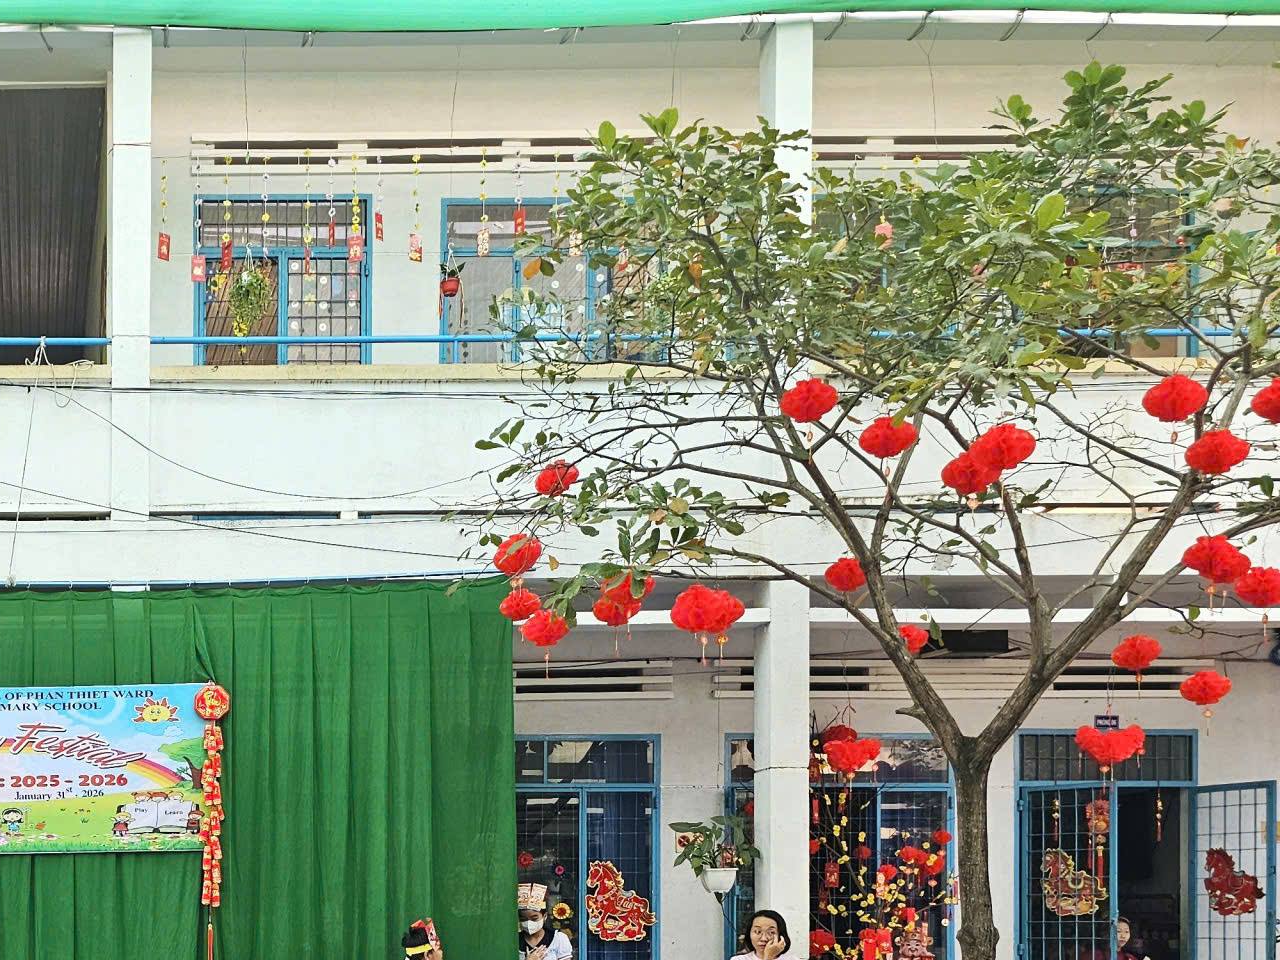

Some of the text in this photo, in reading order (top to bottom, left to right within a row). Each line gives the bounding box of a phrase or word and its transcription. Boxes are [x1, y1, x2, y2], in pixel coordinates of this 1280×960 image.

[4, 692, 24, 700] OF
[27, 691, 64, 700] PHAN
[67, 690, 109, 699] THIET
[113, 690, 154, 698] WARD
[44, 702, 102, 711] SCHOOL
[12, 722, 145, 768] Festival
[10, 774, 60, 788] 2025
[78, 774, 128, 787] 2026
[14, 791, 52, 801] January
[82, 789, 104, 798] 2026
